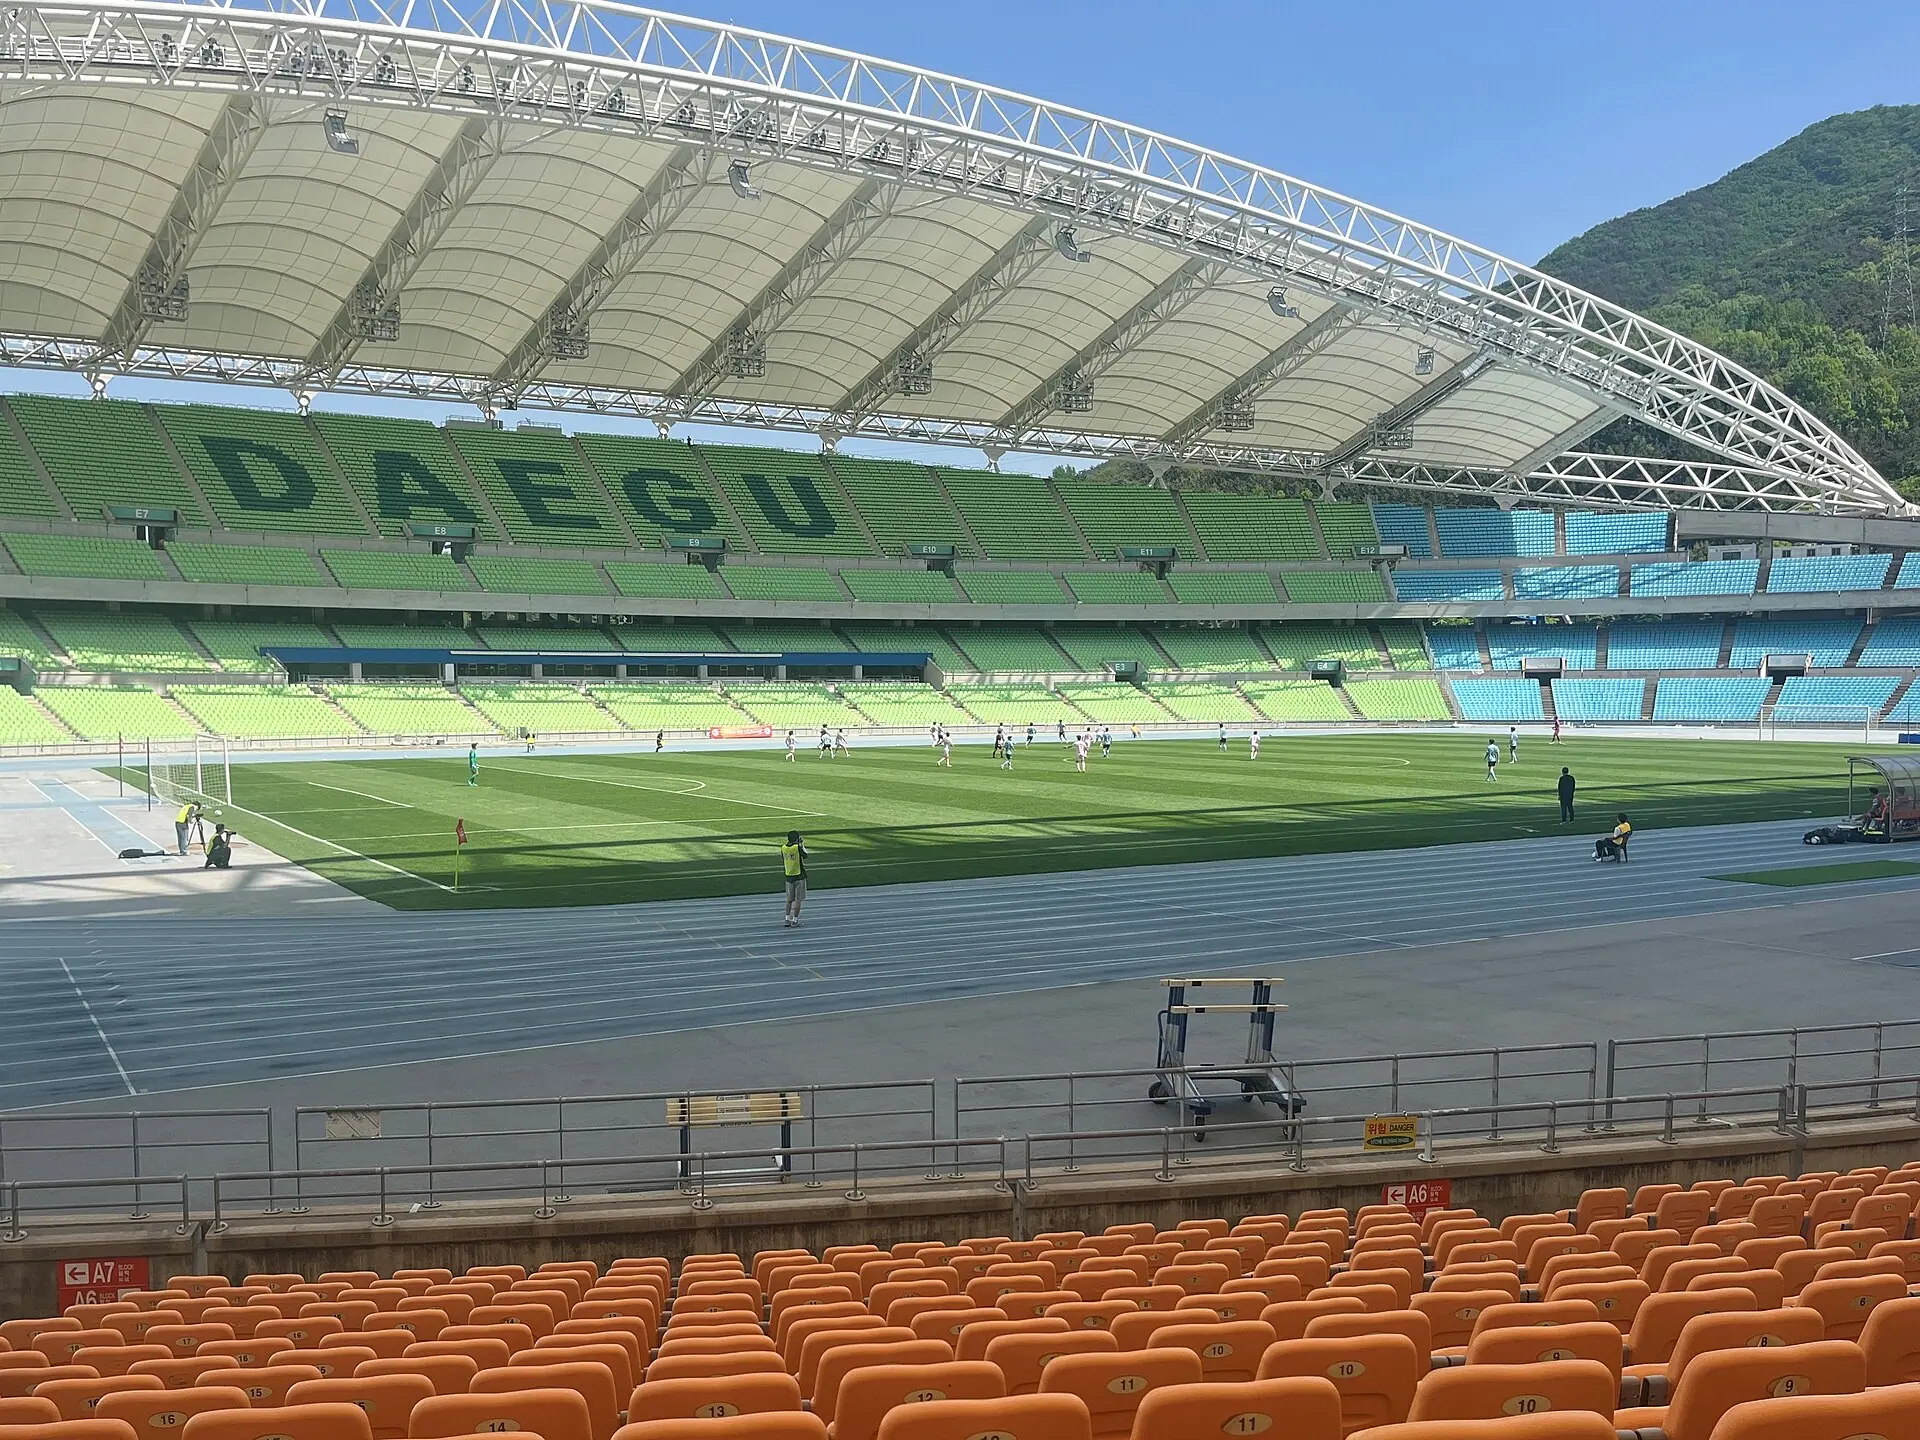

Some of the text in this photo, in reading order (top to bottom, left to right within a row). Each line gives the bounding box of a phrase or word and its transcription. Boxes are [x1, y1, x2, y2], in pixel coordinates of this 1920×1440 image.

[200, 436, 841, 537] DAEGU
[135, 508, 149, 519] E7
[434, 526, 447, 536] E8
[689, 538, 700, 547] E9
[922, 545, 937, 554] E10
[1140, 548, 1153, 556] E11
[1360, 546, 1375, 555] E12
[1115, 663, 1125, 671] E3
[1317, 662, 1328, 670] E4
[1368, 1122, 1387, 1135] 위험
[1389, 1123, 1415, 1132] DANGER
[1408, 1184, 1428, 1204] A6
[92, 1261, 116, 1284] A7
[75, 1289, 98, 1305] A6
[1604, 1300, 1611, 1309] 6
[1859, 1298, 1866, 1307] 6
[1464, 1310, 1471, 1318] 7
[181, 1338, 191, 1346] 17
[1761, 1337, 1768, 1347] 8
[1211, 1346, 1224, 1355] 10
[238, 1355, 248, 1363] 16
[1339, 1364, 1354, 1376] 10
[1120, 1378, 1135, 1391] 11
[1785, 1379, 1794, 1393] 9
[250, 1388, 262, 1398] 15
[917, 1392, 933, 1402] 12
[708, 1405, 725, 1418] 13
[1517, 1399, 1537, 1414] 10
[160, 1414, 176, 1426] 16
[1238, 1416, 1257, 1432] 11
[489, 1421, 507, 1433] 14
